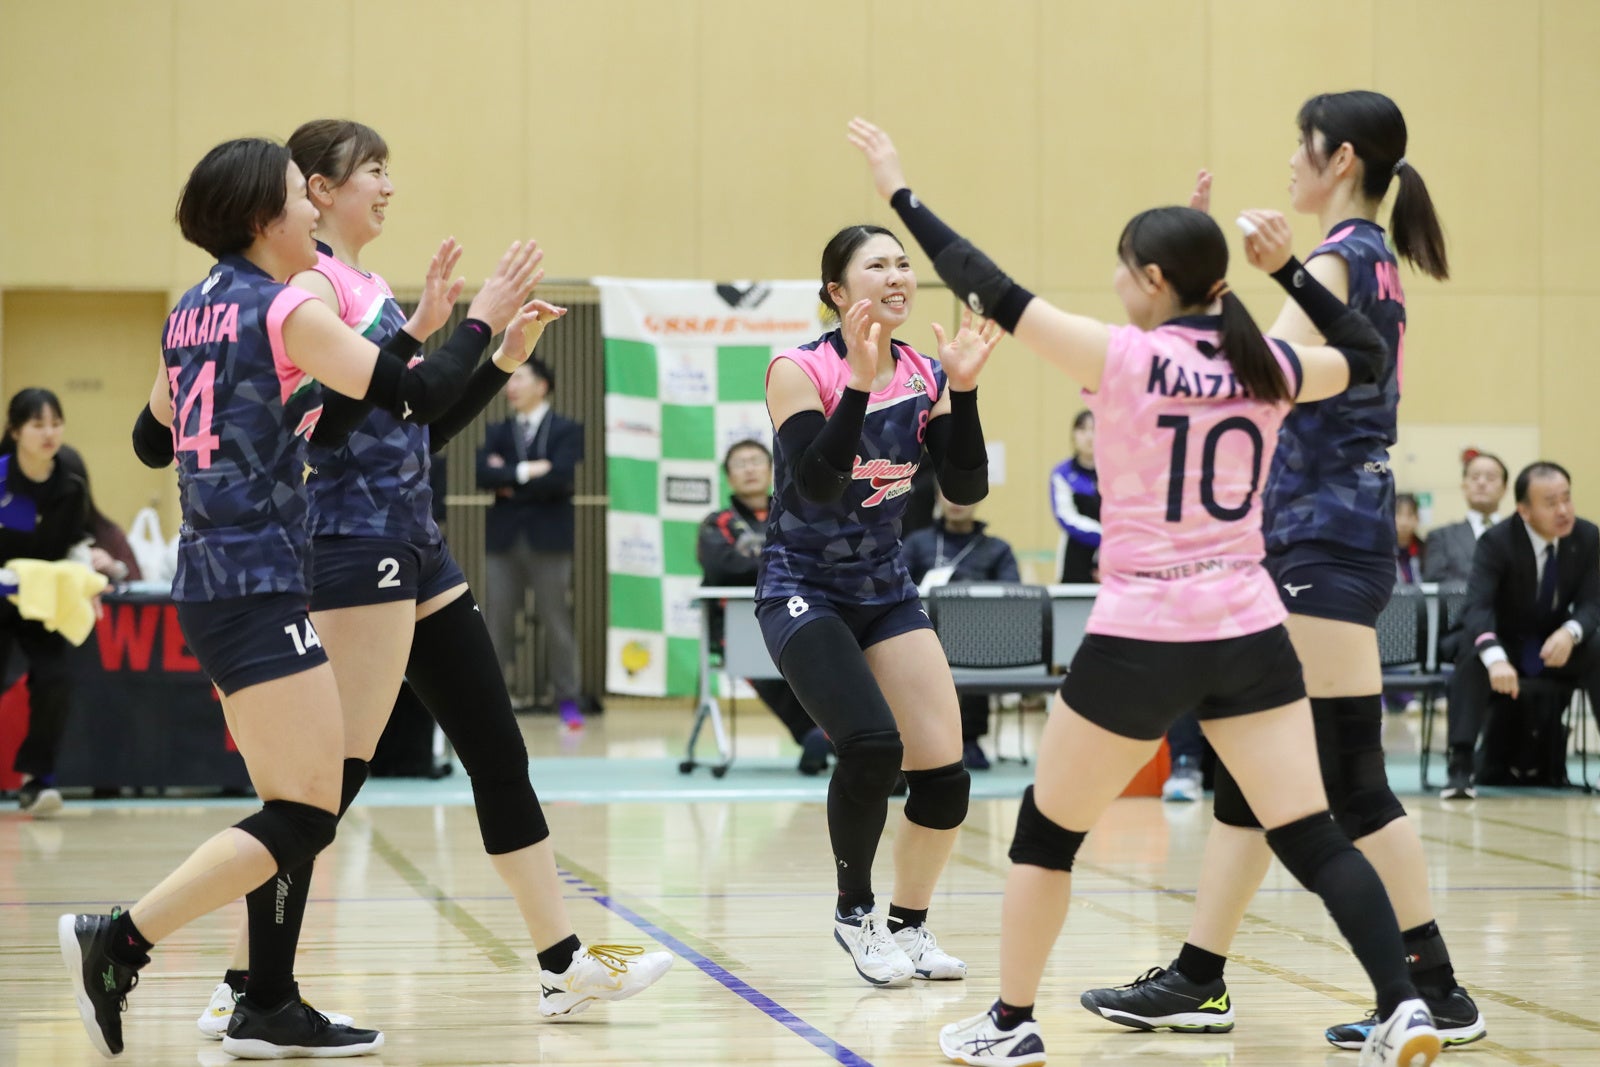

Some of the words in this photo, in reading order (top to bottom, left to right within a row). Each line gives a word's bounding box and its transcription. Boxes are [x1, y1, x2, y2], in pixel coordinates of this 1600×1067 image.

[1156, 414, 1264, 523] 10
[377, 557, 401, 589] 2
[786, 595, 810, 618] 8
[284, 617, 322, 656] 14
